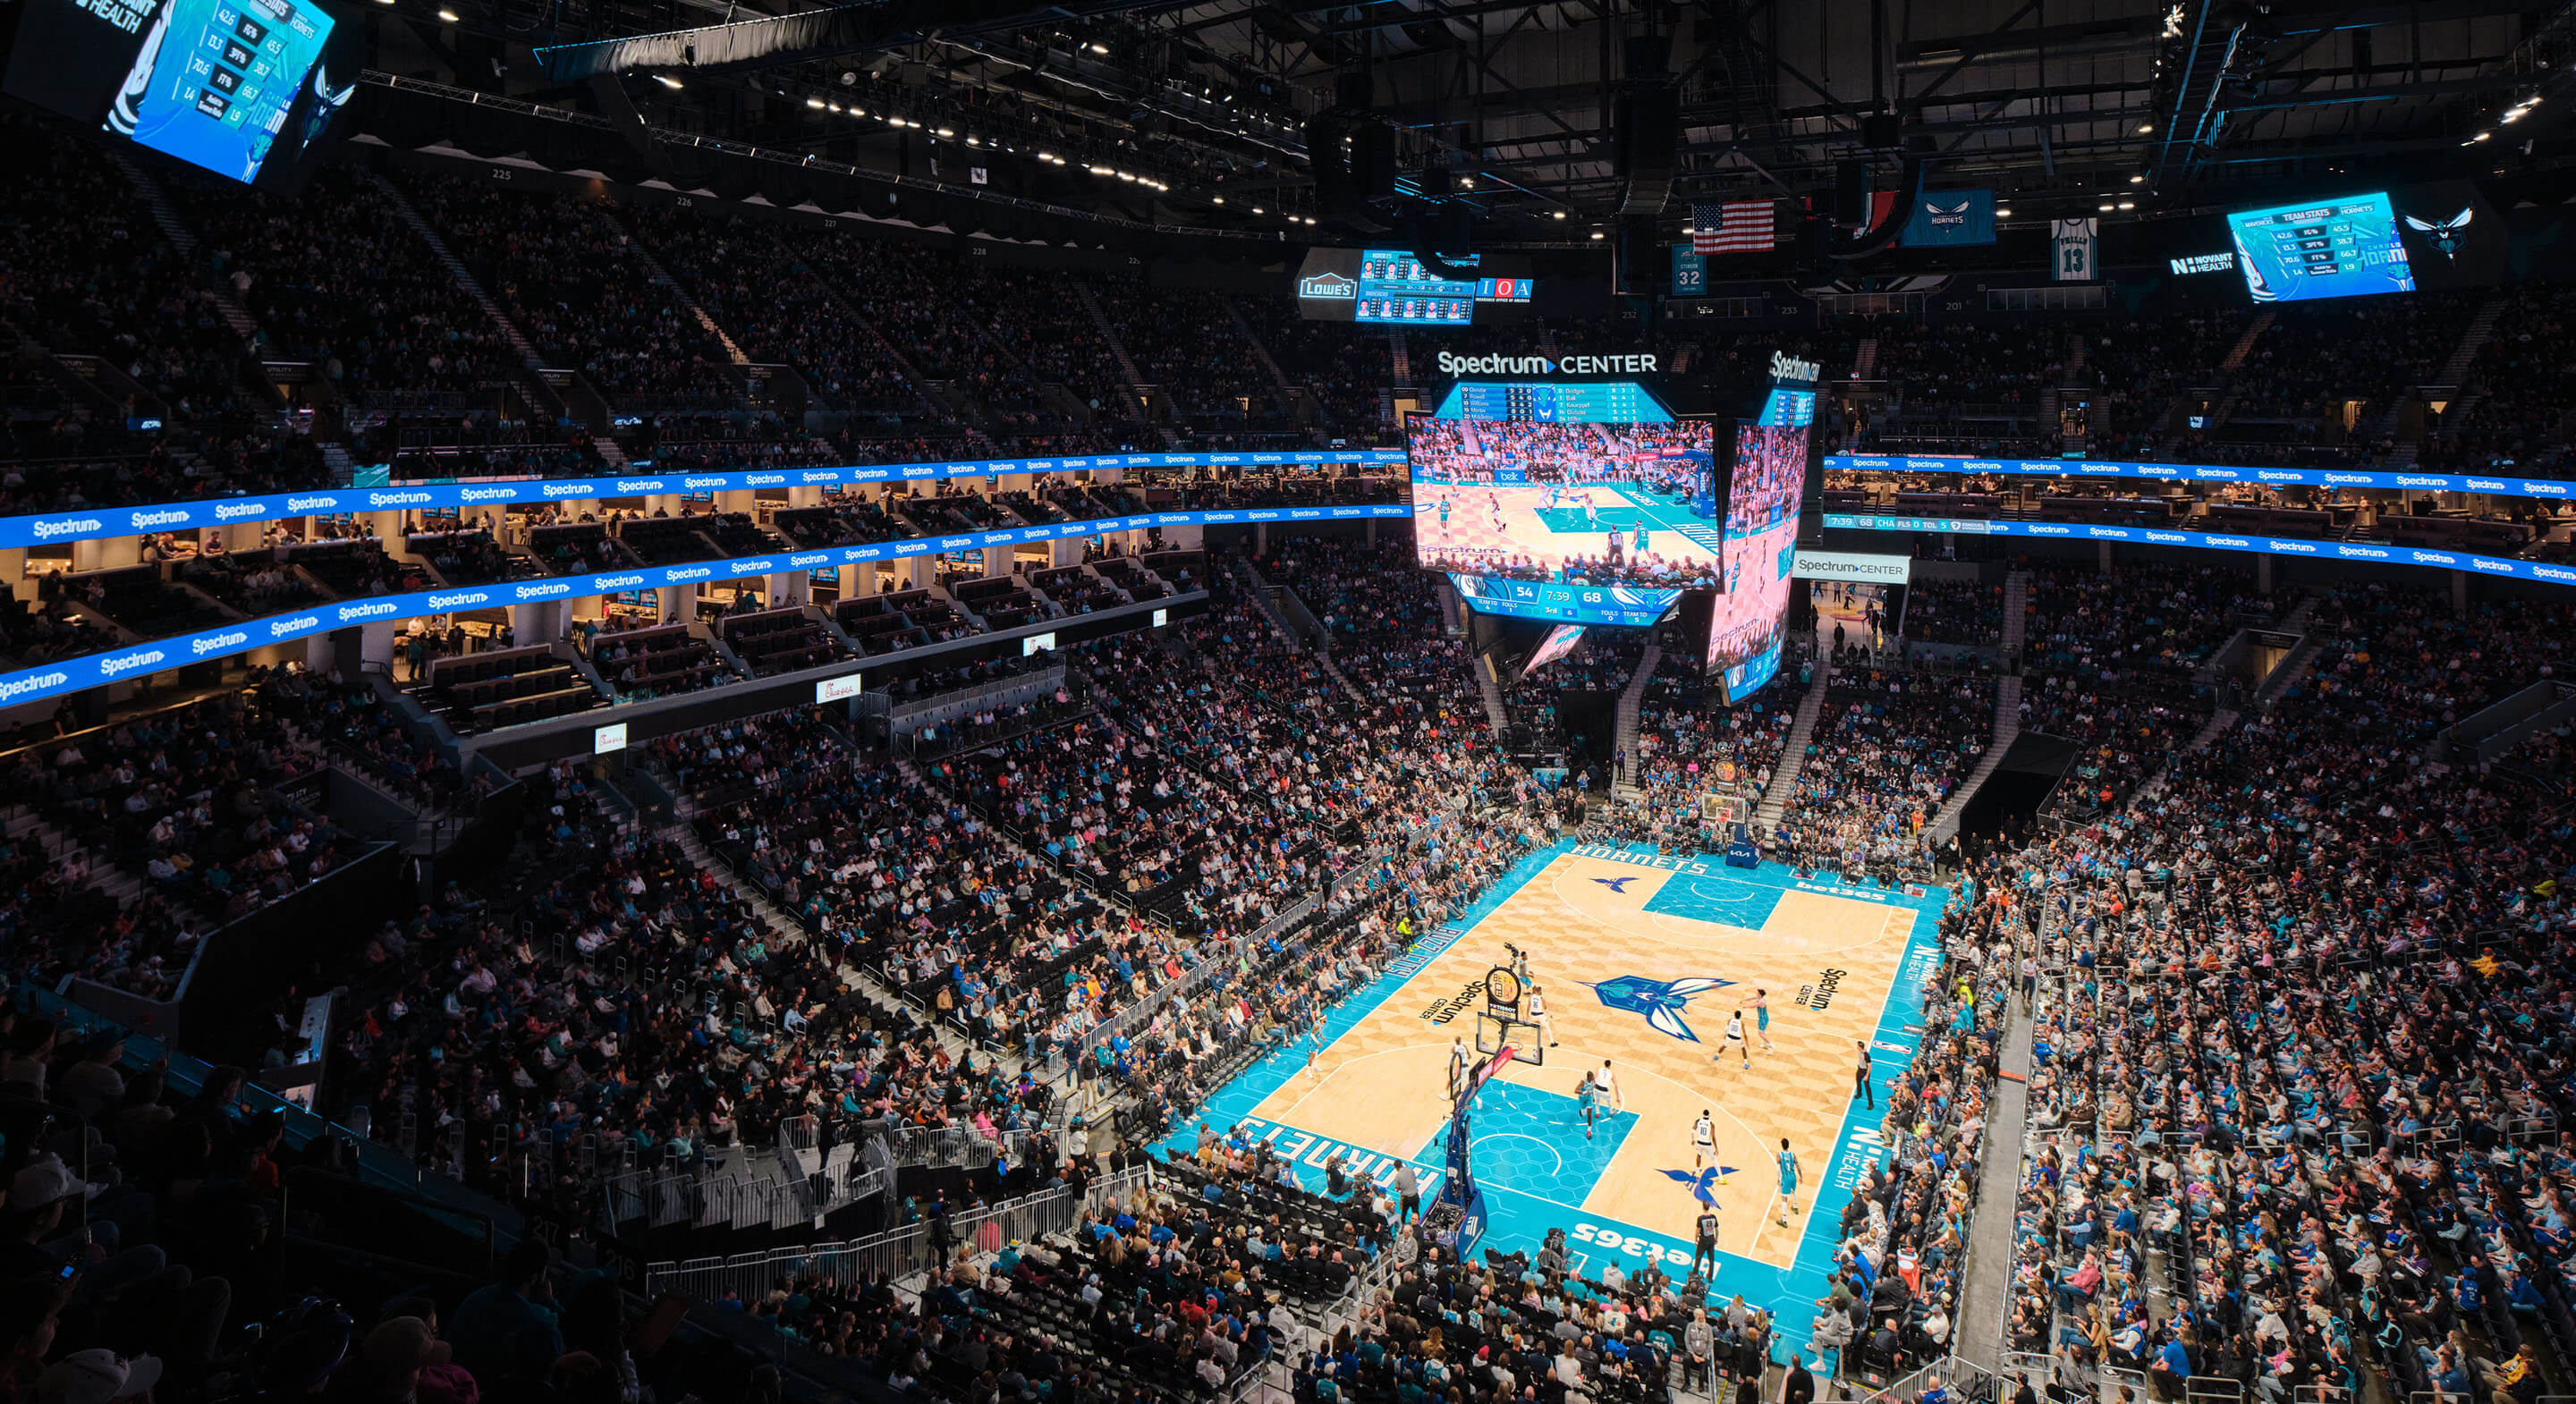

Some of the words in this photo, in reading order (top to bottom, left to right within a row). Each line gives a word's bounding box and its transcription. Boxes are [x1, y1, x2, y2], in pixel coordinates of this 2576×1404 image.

[89, 0, 142, 34] HEALTH
[218, 8, 236, 26] 42.6
[290, 17, 315, 39] HORNETS
[191, 58, 210, 75] 70.6
[493, 168, 513, 181] 225
[677, 197, 692, 207] 226
[2282, 211, 2305, 222] TEAM
[2305, 207, 2331, 219] STATS
[2340, 206, 2373, 216] HORNETS
[1931, 216, 1964, 224] HORNETS
[2244, 218, 2275, 228] MAVERICKS
[2063, 249, 2084, 273] 13
[2194, 253, 2233, 264] NOVANT
[2283, 255, 2301, 264] 70.6
[2340, 250, 2356, 258] 66.7
[2196, 261, 2233, 272] HEALTH
[1678, 271, 1700, 285] 32
[1305, 281, 1352, 296] LOWE'S
[1781, 307, 1798, 316] 233
[1945, 301, 1962, 311] 201
[266, 365, 292, 373] UTILITY
[1437, 351, 1547, 378] Spectrum
[1560, 354, 1658, 374] CENTER
[1772, 350, 1809, 385] Spectrum
[1165, 455, 1193, 463] Spectrum
[1374, 452, 1404, 461] Spectrum
[1852, 459, 1887, 467] Spectrum
[1905, 460, 1942, 470] Spectrum
[1962, 461, 1999, 471] Spectrum
[2021, 462, 2058, 472] Spectrum
[2081, 463, 2118, 472] Spectrum
[802, 471, 836, 482] Spectrum
[854, 469, 886, 479] Spectrum
[902, 467, 931, 477] Spectrum
[1500, 471, 1519, 481] belk
[2138, 465, 2174, 476] Spectrum
[2196, 468, 2235, 478] Spectrum
[2258, 470, 2300, 479] Spectrum
[684, 477, 724, 489] Spectrum
[746, 474, 783, 486] Spectrum
[2324, 473, 2370, 484] Spectrum
[2396, 476, 2445, 486] Spectrum
[2467, 478, 2503, 489] Spectrum
[543, 484, 590, 497] Spectrum
[617, 480, 660, 493] Spectrum
[2524, 482, 2563, 494] Spectrum
[369, 492, 428, 507] Spectrum
[461, 487, 513, 502] Spectrum
[287, 496, 334, 512] Spectrum
[215, 503, 262, 520] Spectrum
[1204, 513, 1233, 521] Spectrum
[131, 510, 186, 529] Spectrum
[1158, 514, 1188, 522] Spectrum
[1831, 517, 1853, 526] 7:39
[1859, 519, 1874, 527] 68
[1877, 519, 1895, 528] CHA
[1940, 521, 1947, 529] 5
[33, 519, 97, 538] Spectrum
[2028, 524, 2066, 533] Spectrum
[2089, 527, 2126, 537] Spectrum
[2146, 531, 2183, 541] Spectrum
[2206, 536, 2246, 546] Spectrum
[895, 543, 926, 554] Spectrum
[2270, 540, 2313, 551] Spectrum
[2339, 546, 2385, 557] Spectrum
[845, 548, 877, 560] Spectrum
[2413, 551, 2453, 563] Spectrum
[791, 554, 826, 567] Spectrum
[2473, 558, 2510, 571] Spectrum
[731, 561, 769, 573] Spectrum
[1798, 559, 1855, 572] Spectrum
[1860, 564, 1903, 575] CENTER
[2533, 565, 2572, 579] Spectrum
[666, 568, 708, 581] Spectrum
[595, 575, 641, 590] Spectrum
[516, 583, 566, 599] Spectrum
[1516, 587, 1533, 598] 54
[1546, 590, 1571, 602] 7:39
[1582, 592, 1602, 603] 68
[428, 593, 484, 609] Spectrum
[339, 603, 394, 621] Spectrum
[271, 616, 315, 637] Spectrum
[192, 632, 243, 655] Spectrum
[100, 650, 161, 675] Spectrum
[1571, 845, 1711, 875] HORNETS
[1796, 881, 1886, 901] bet365
[1419, 927, 1464, 953] BUZZ
[1903, 960, 1922, 981] HEALTH
[1794, 984, 1813, 1006] CENTER
[1810, 968, 1848, 1010] Spectrum
[1434, 980, 1487, 1024] Spectrum
[1496, 1003, 1517, 1013] TISSOT
[1419, 998, 1447, 1019] CENTER
[1699, 1126, 1707, 1137] 10
[1835, 1150, 1859, 1190] HEALTH
[530, 1213, 559, 1246] 217
